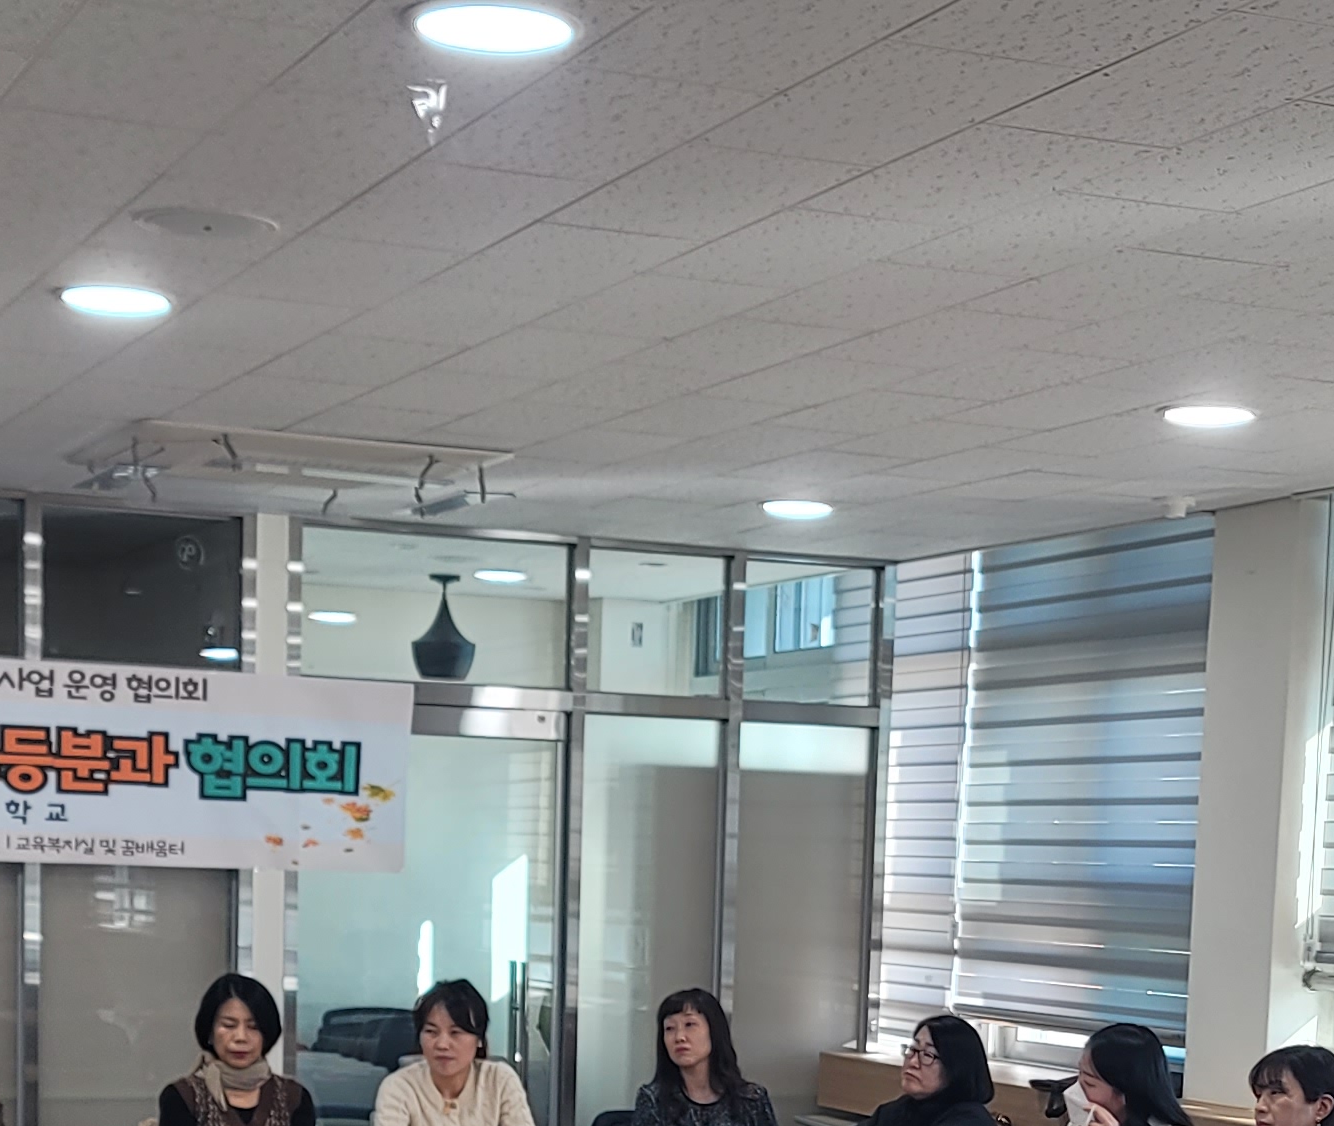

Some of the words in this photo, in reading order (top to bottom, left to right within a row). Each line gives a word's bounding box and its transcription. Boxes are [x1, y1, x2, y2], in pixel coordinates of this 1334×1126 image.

[63, 669, 117, 702] 운영
[125, 673, 208, 704] 협의회
[183, 732, 361, 801] 협의회
[17, 836, 95, 853] 교육복지실
[99, 839, 116, 855] 및
[120, 839, 185, 857] 꿈배움터
